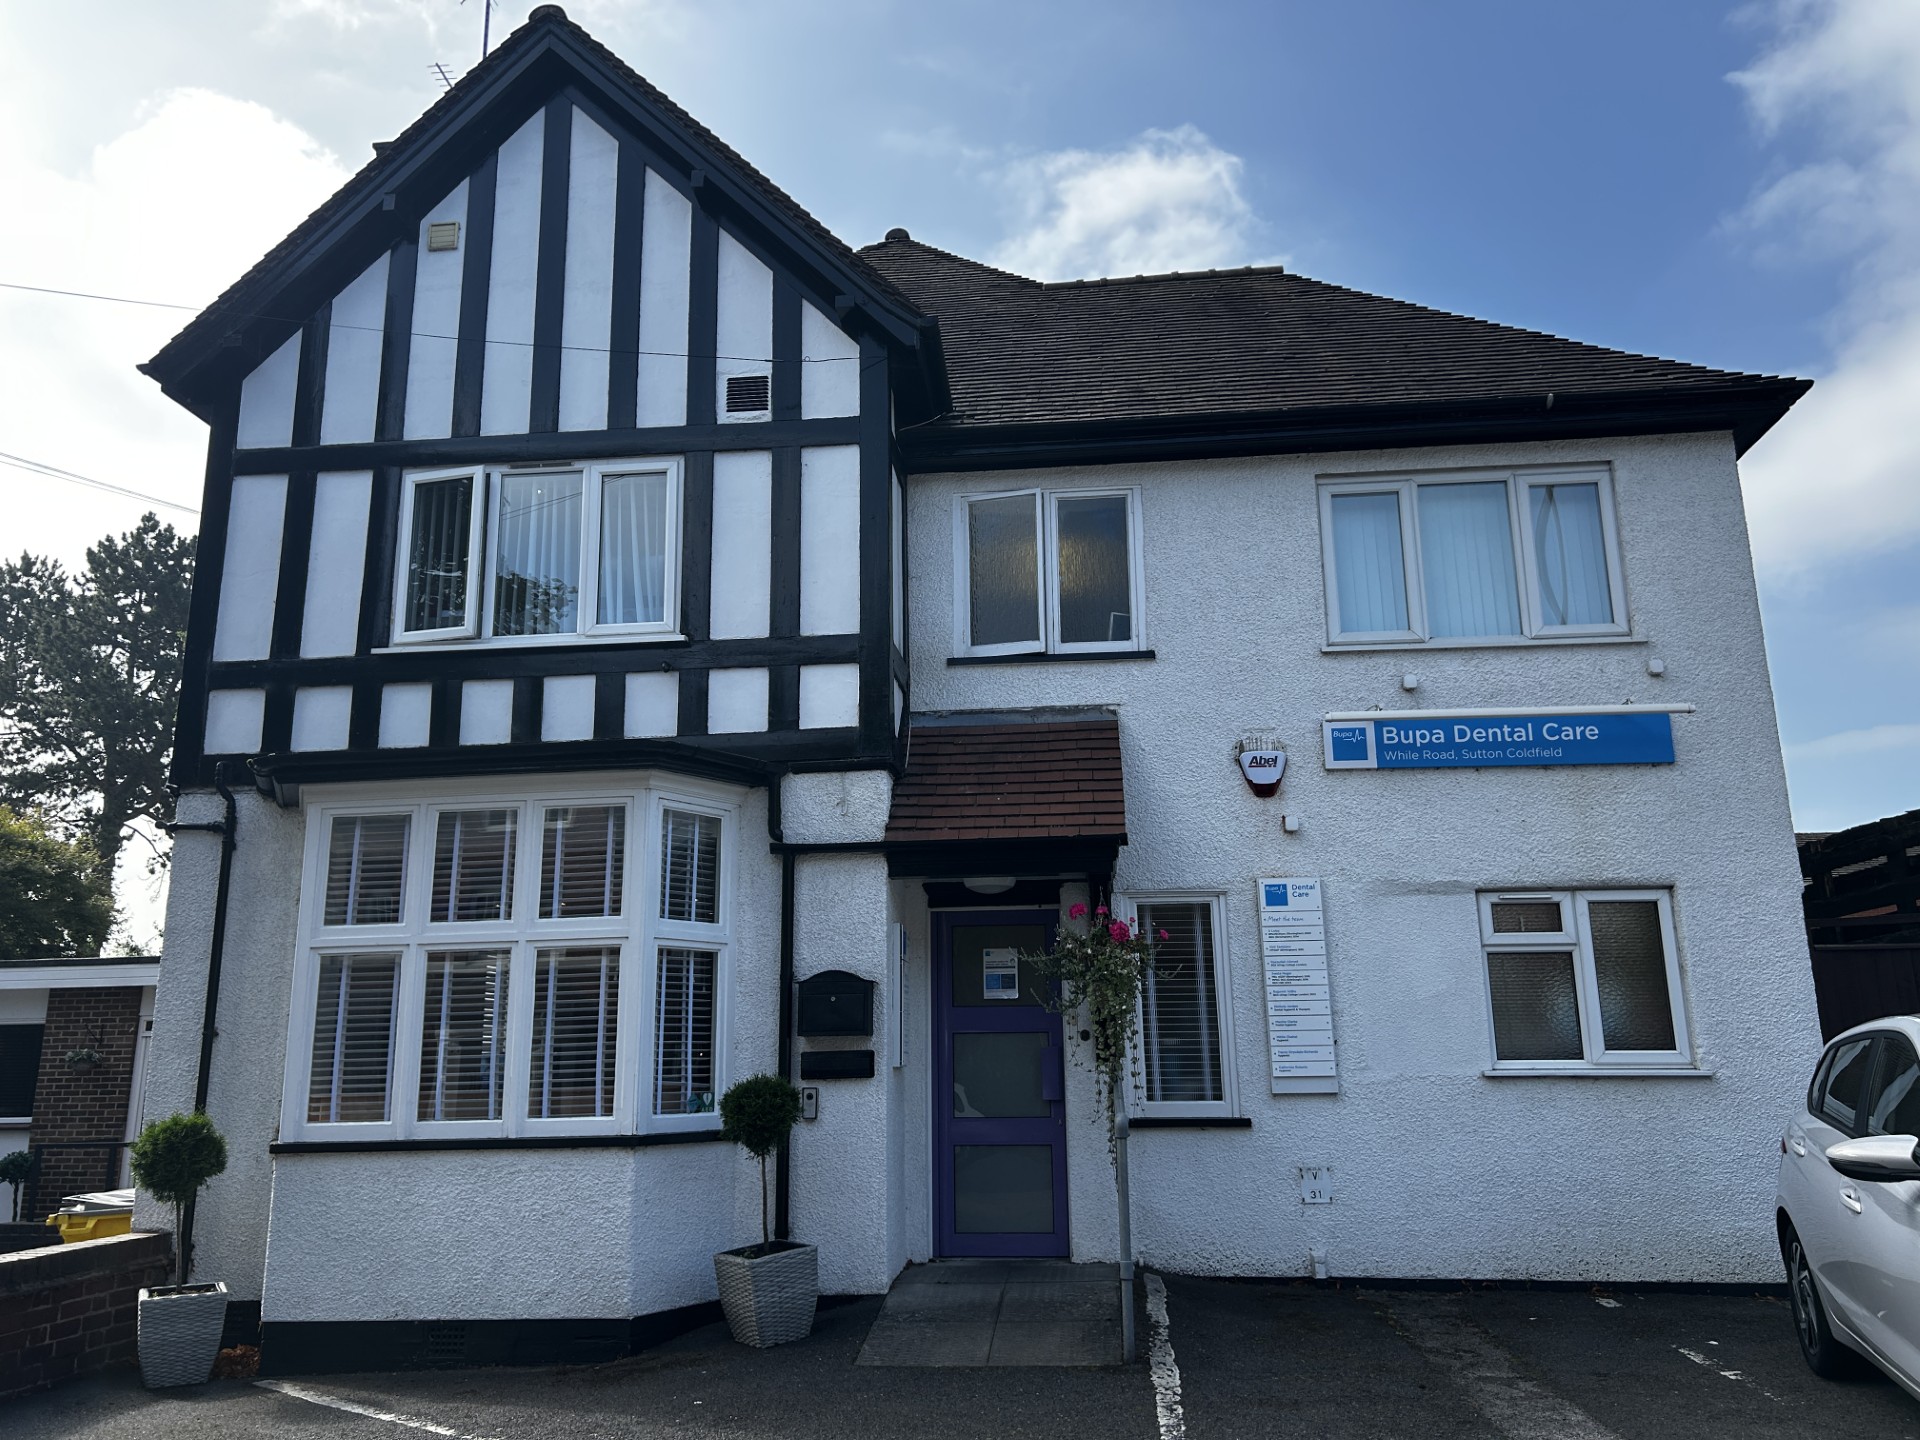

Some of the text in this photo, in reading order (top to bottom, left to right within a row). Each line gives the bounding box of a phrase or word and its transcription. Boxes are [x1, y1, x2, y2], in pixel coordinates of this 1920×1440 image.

[1333, 730, 1353, 739] Bupa
[1382, 722, 1599, 747] Bupa Dental Care
[1384, 747, 1562, 761] While Road, Sutton Coldfield
[1249, 755, 1278, 766] Abel
[1310, 1190, 1322, 1199] 31
